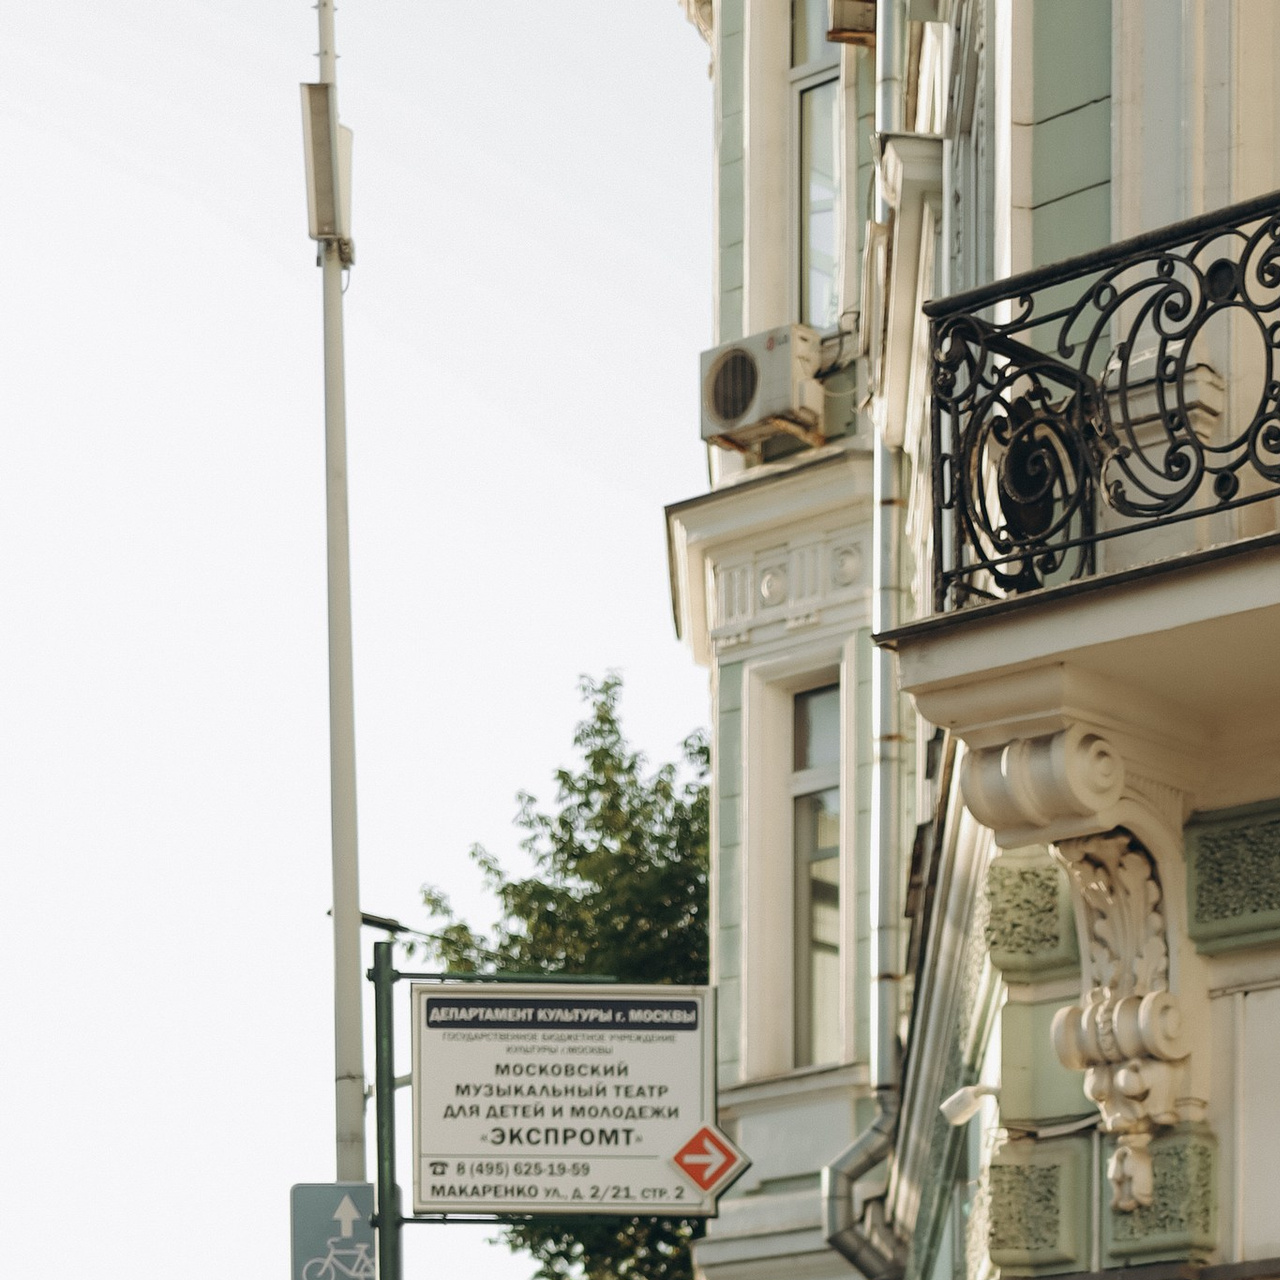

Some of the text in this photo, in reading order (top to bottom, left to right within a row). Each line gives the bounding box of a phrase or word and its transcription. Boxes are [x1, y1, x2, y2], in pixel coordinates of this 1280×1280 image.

[429, 1007, 535, 1023] ДЕПАРТАМЕНТ
[537, 1008, 612, 1022] КУЛЬТУРЫ
[628, 1009, 696, 1024] МОСКВЫ
[494, 1061, 629, 1077] МОСКОВСКИЙ
[455, 1081, 669, 1098] МУЗЫКАЛЬНЫЙ ТЕАТР
[443, 1102, 680, 1120] ДЛЯ ДЕТЕЙ И МОЛОДЕЖИ
[480, 1127, 643, 1146] «ЭКСПРОМТ»
[456, 1161, 591, 1179] 8 (495) 625-19-59
[431, 1184, 539, 1198] МАКАРЕНКО
[675, 1186, 685, 1199] 2
